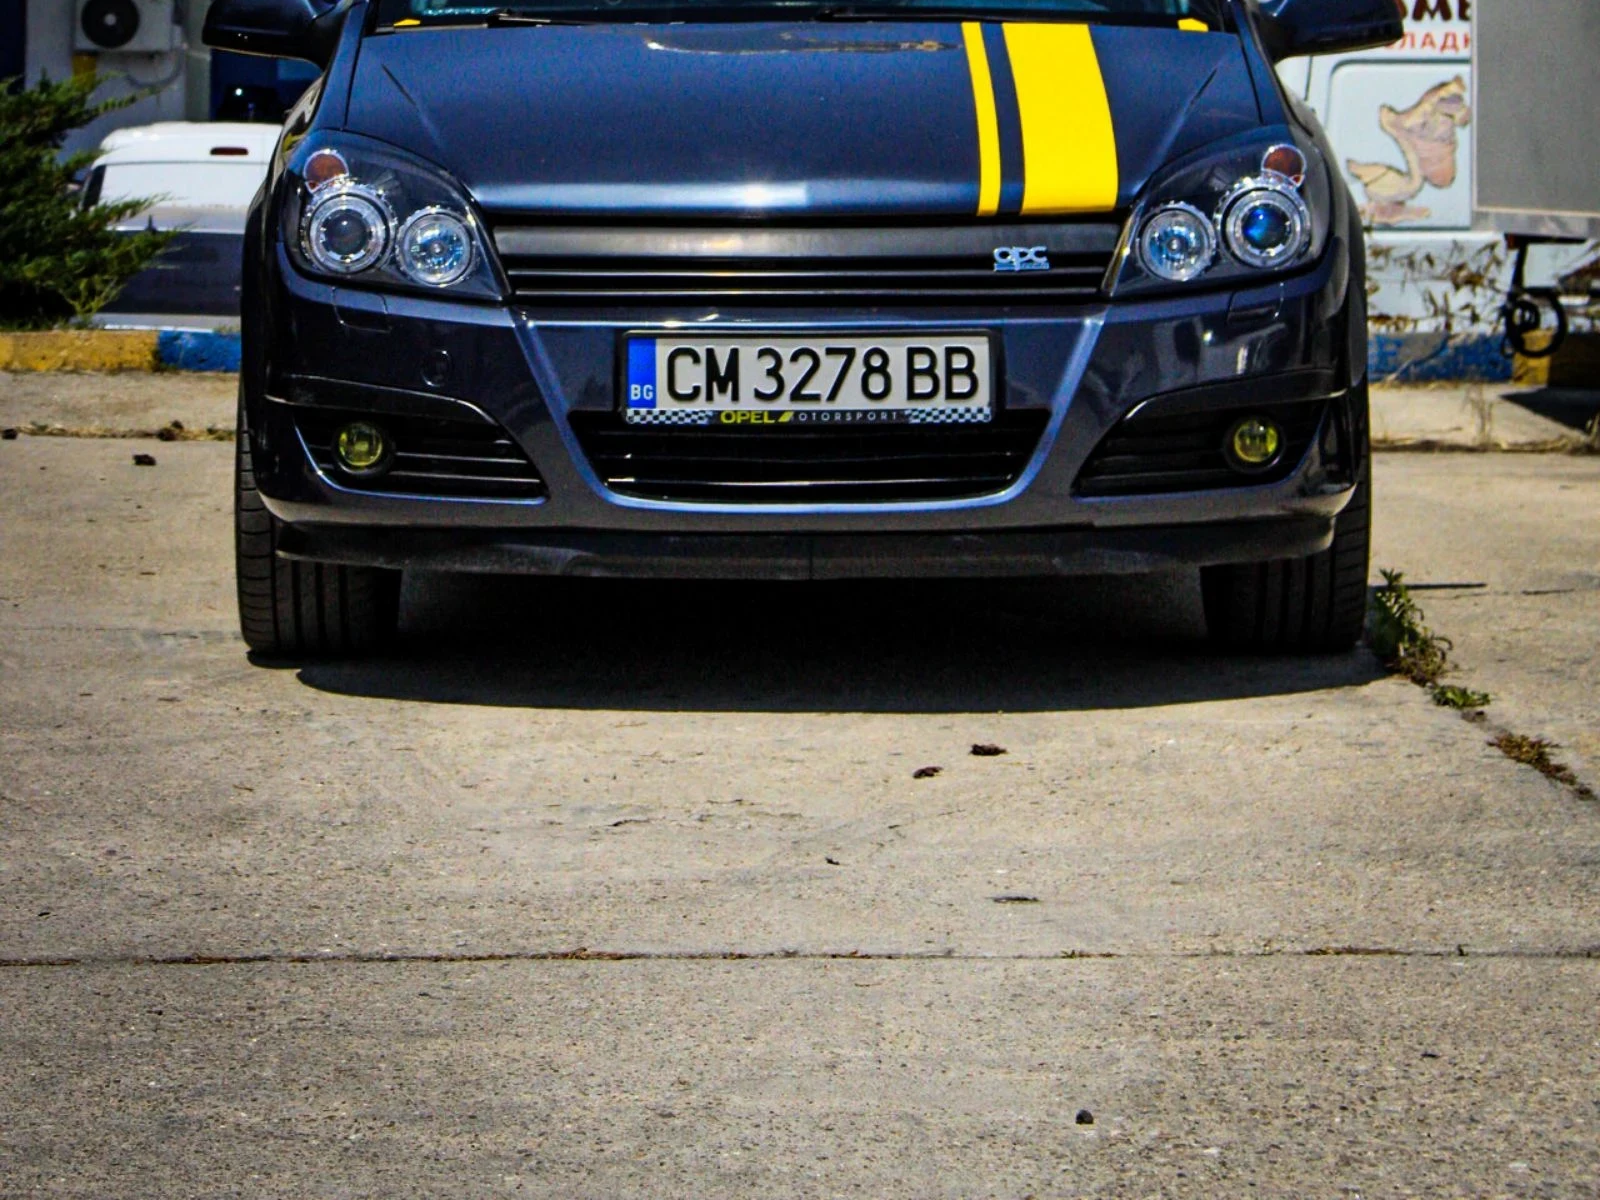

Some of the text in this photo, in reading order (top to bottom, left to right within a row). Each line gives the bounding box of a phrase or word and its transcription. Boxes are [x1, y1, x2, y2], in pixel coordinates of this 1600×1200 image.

[753, 347, 892, 402] 3278
[630, 384, 654, 401] BG
[720, 410, 898, 424] OPEL OTORSPORT
